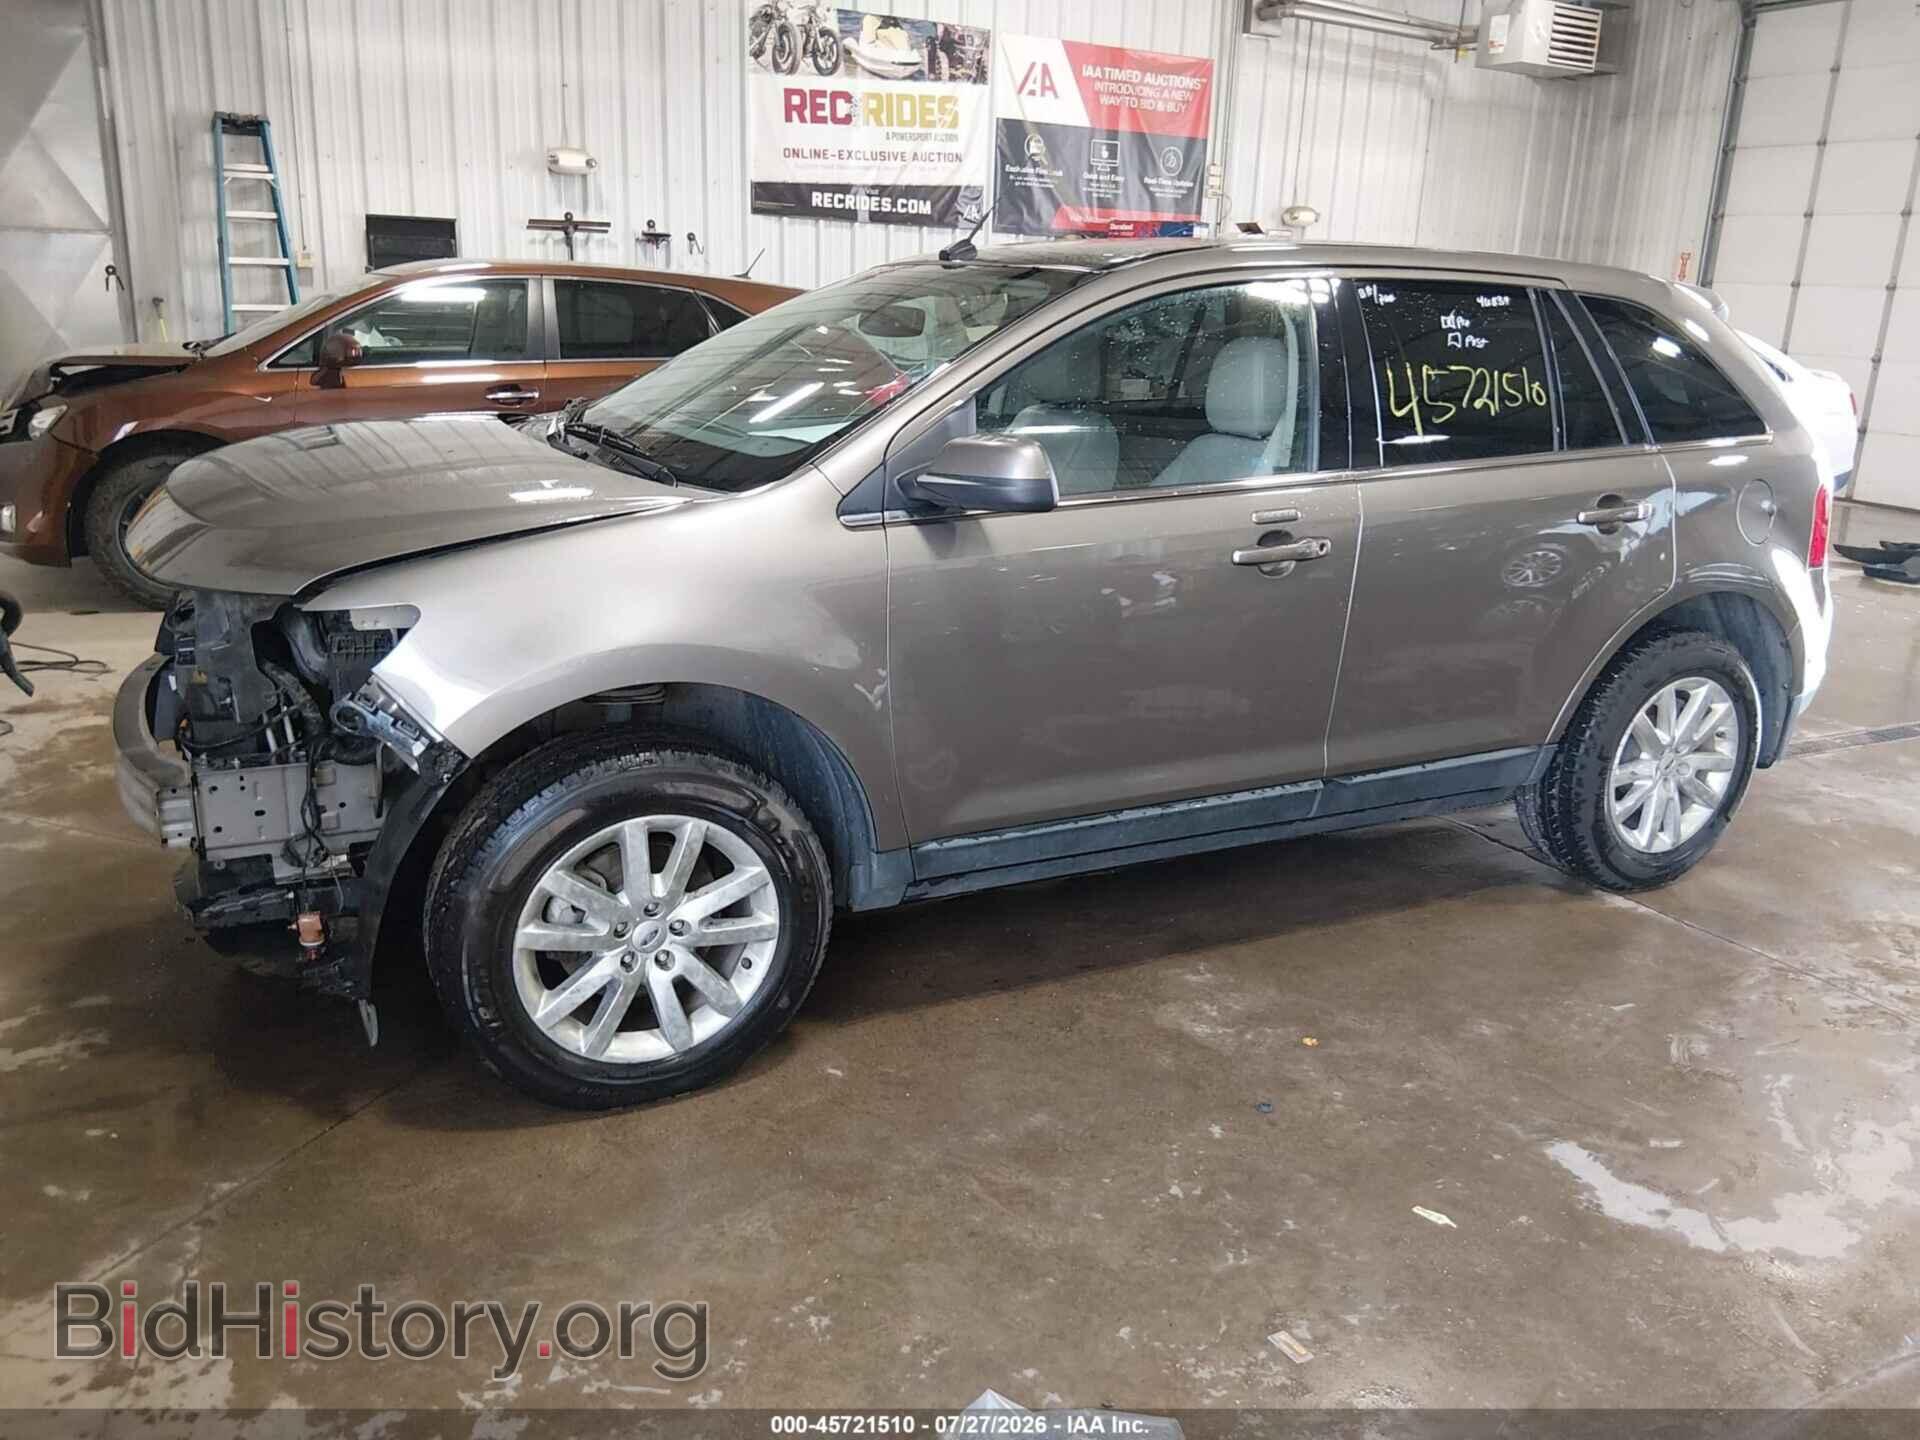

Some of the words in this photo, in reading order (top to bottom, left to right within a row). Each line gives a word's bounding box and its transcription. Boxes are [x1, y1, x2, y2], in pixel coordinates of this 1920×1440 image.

[1082, 64, 1102, 78] IAA
[1104, 66, 1141, 82] TIMED
[783, 88, 854, 125] REC
[863, 92, 959, 129] RIDES
[1100, 95, 1122, 107] WAY
[1123, 96, 1138, 108] TO
[1139, 98, 1155, 111] BID
[1167, 100, 1188, 113] BUY
[783, 147, 907, 162] ONLINE-EXCLUSIVE
[911, 152, 964, 163] AUCTION
[811, 191, 932, 215] RECRIDES.COM
